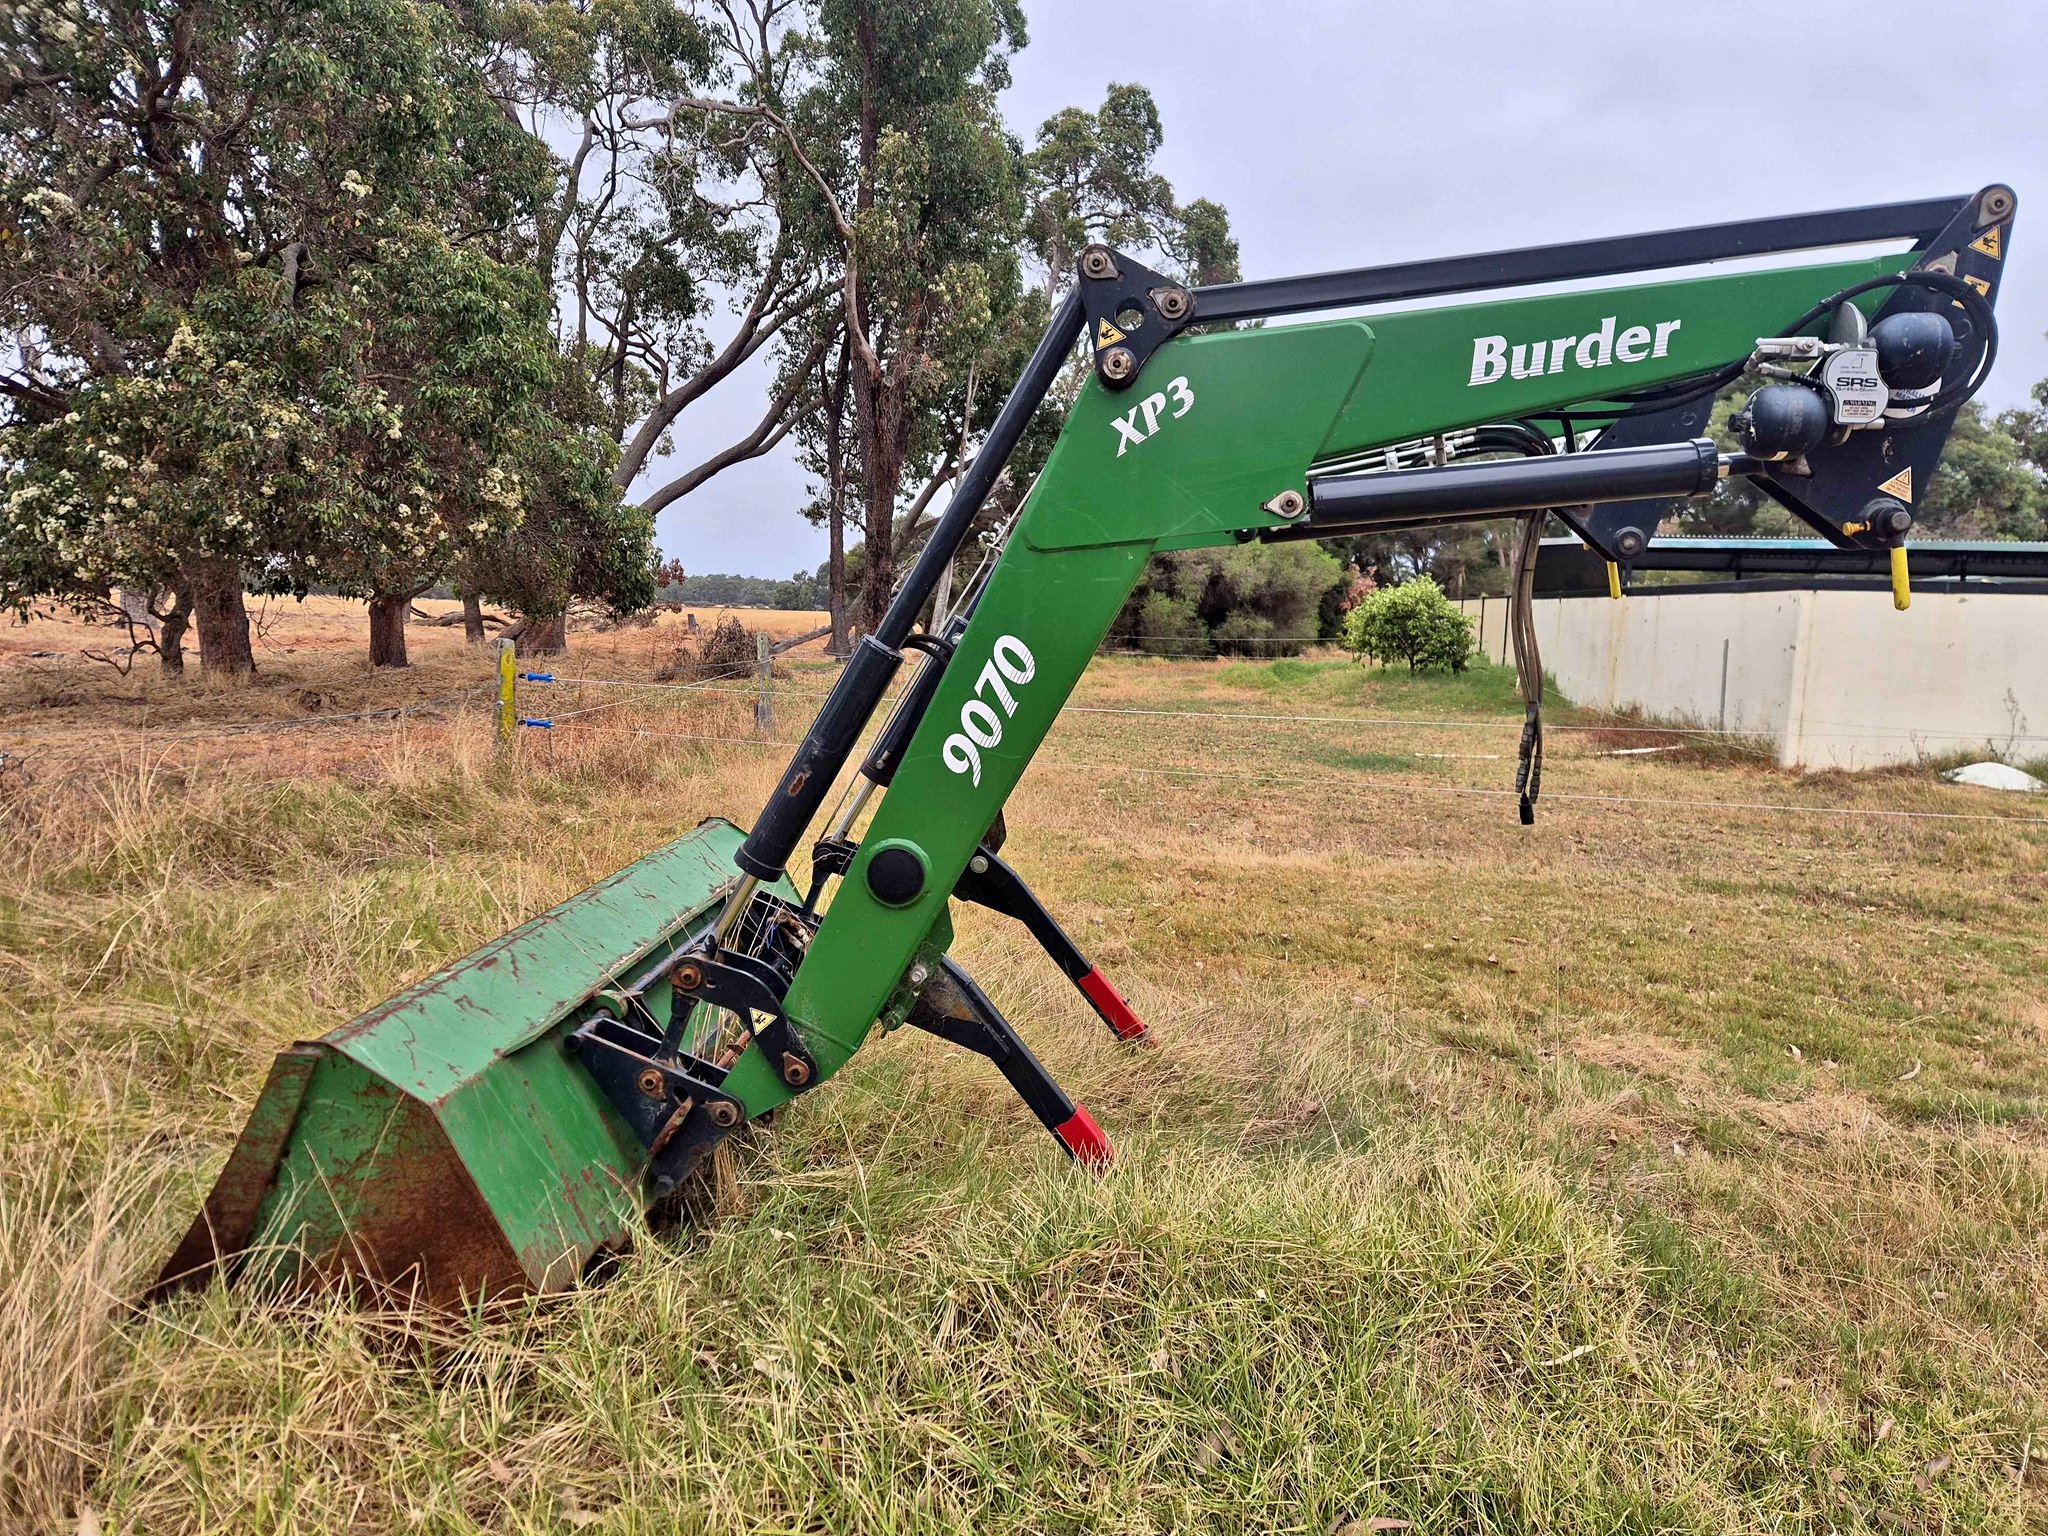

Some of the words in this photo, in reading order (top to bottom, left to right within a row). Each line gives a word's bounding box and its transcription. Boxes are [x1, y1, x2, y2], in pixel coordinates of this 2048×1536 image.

[1467, 316, 1681, 386] Burder
[1836, 377, 1878, 387] SRS
[1110, 376, 1195, 457] XP3
[942, 635, 1036, 788] 9070
